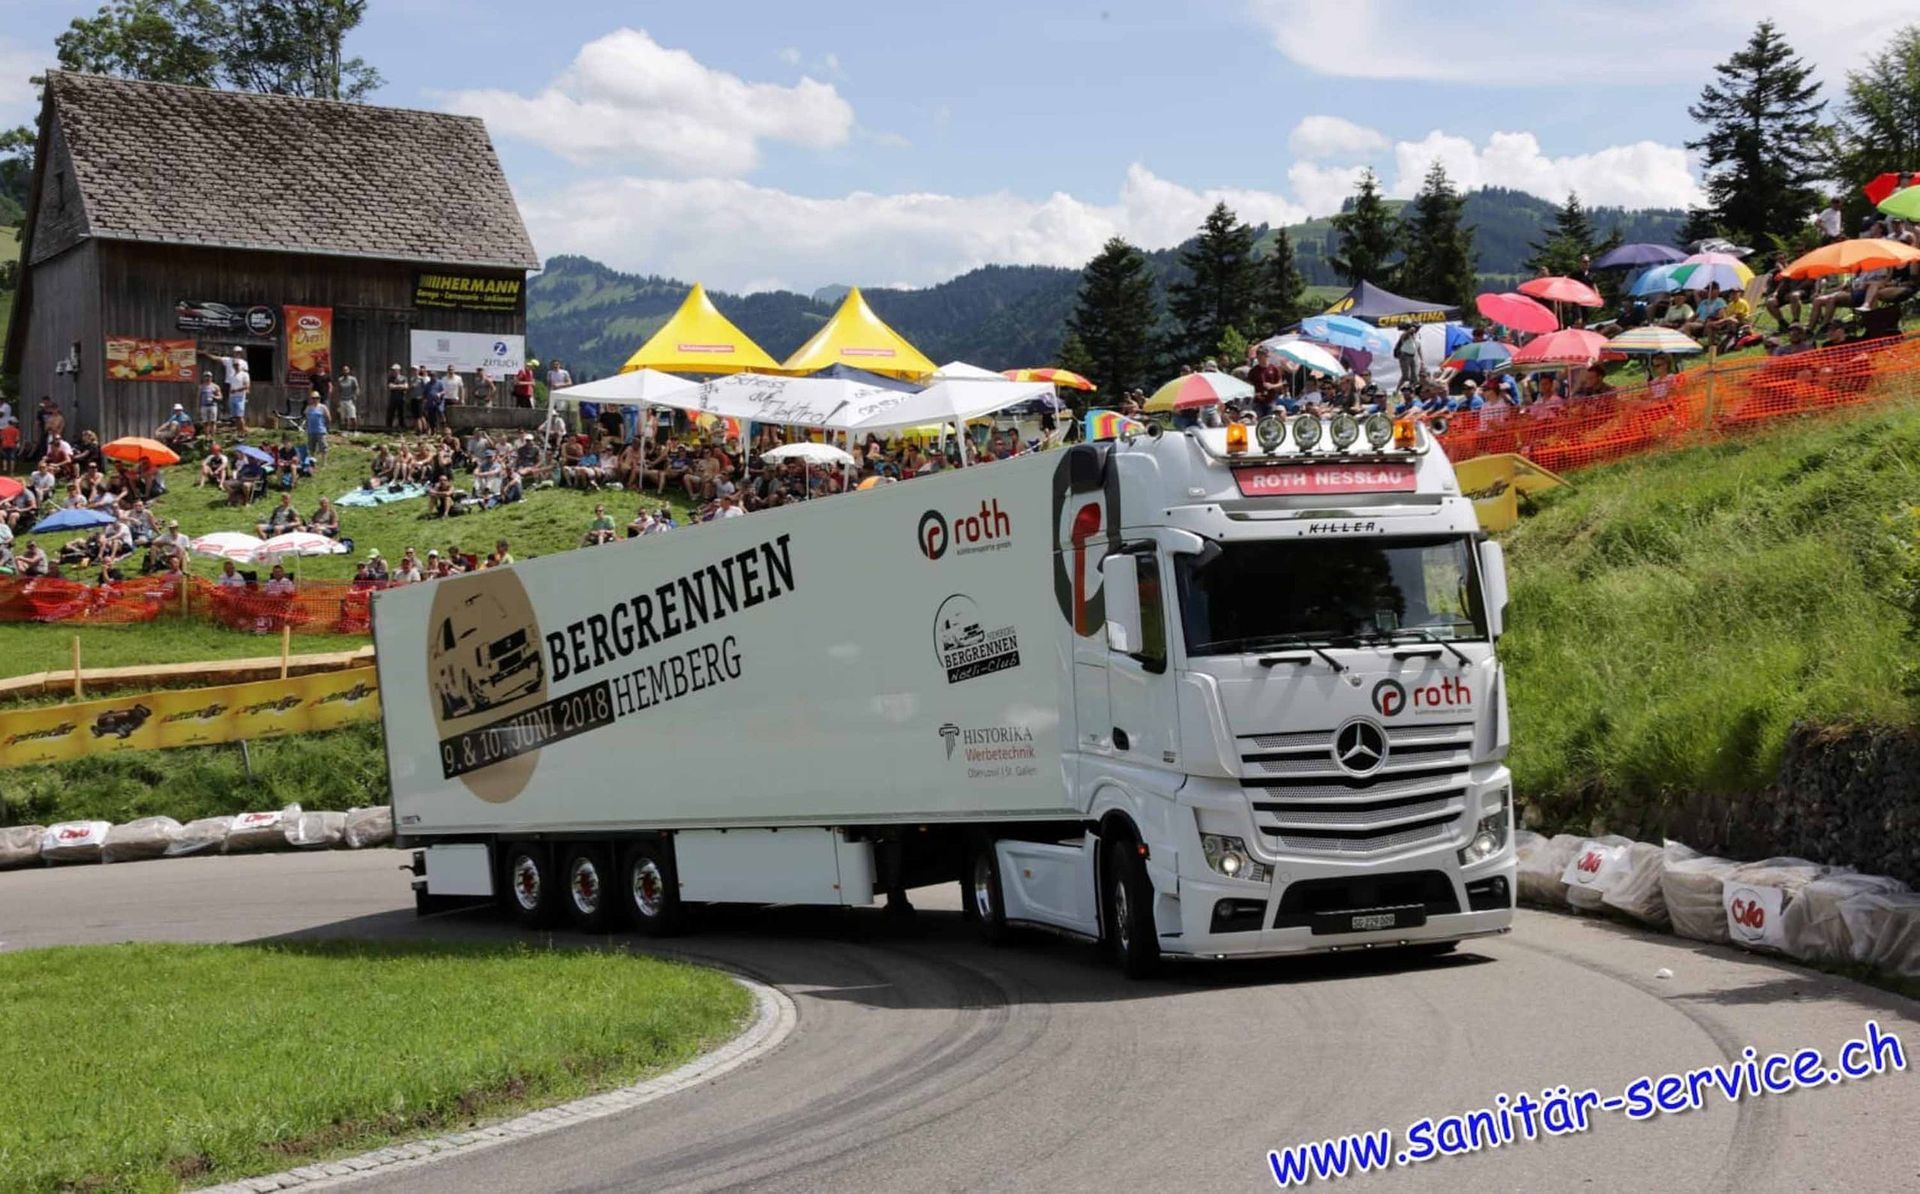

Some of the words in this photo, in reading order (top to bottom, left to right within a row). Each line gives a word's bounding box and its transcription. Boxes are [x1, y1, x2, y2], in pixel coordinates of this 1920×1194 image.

[440, 276, 520, 293] HERMANN
[1252, 474, 1306, 488] ROTH
[1315, 471, 1402, 485] NESSLAU
[954, 498, 1010, 544] roth
[1309, 522, 1375, 534] KILLER
[546, 534, 795, 683] BERGRENNEN
[944, 635, 1018, 668] BERGRENNEN
[613, 635, 742, 718] HEMBERG
[1413, 676, 1471, 706] roth
[444, 744, 462, 773] 9.
[464, 737, 477, 766] &
[480, 729, 508, 759] 10.
[511, 704, 558, 749] JUNI
[561, 688, 609, 731] 2018
[963, 727, 1033, 744] HISTORIKA
[965, 745, 1035, 761] Werbetechnik
